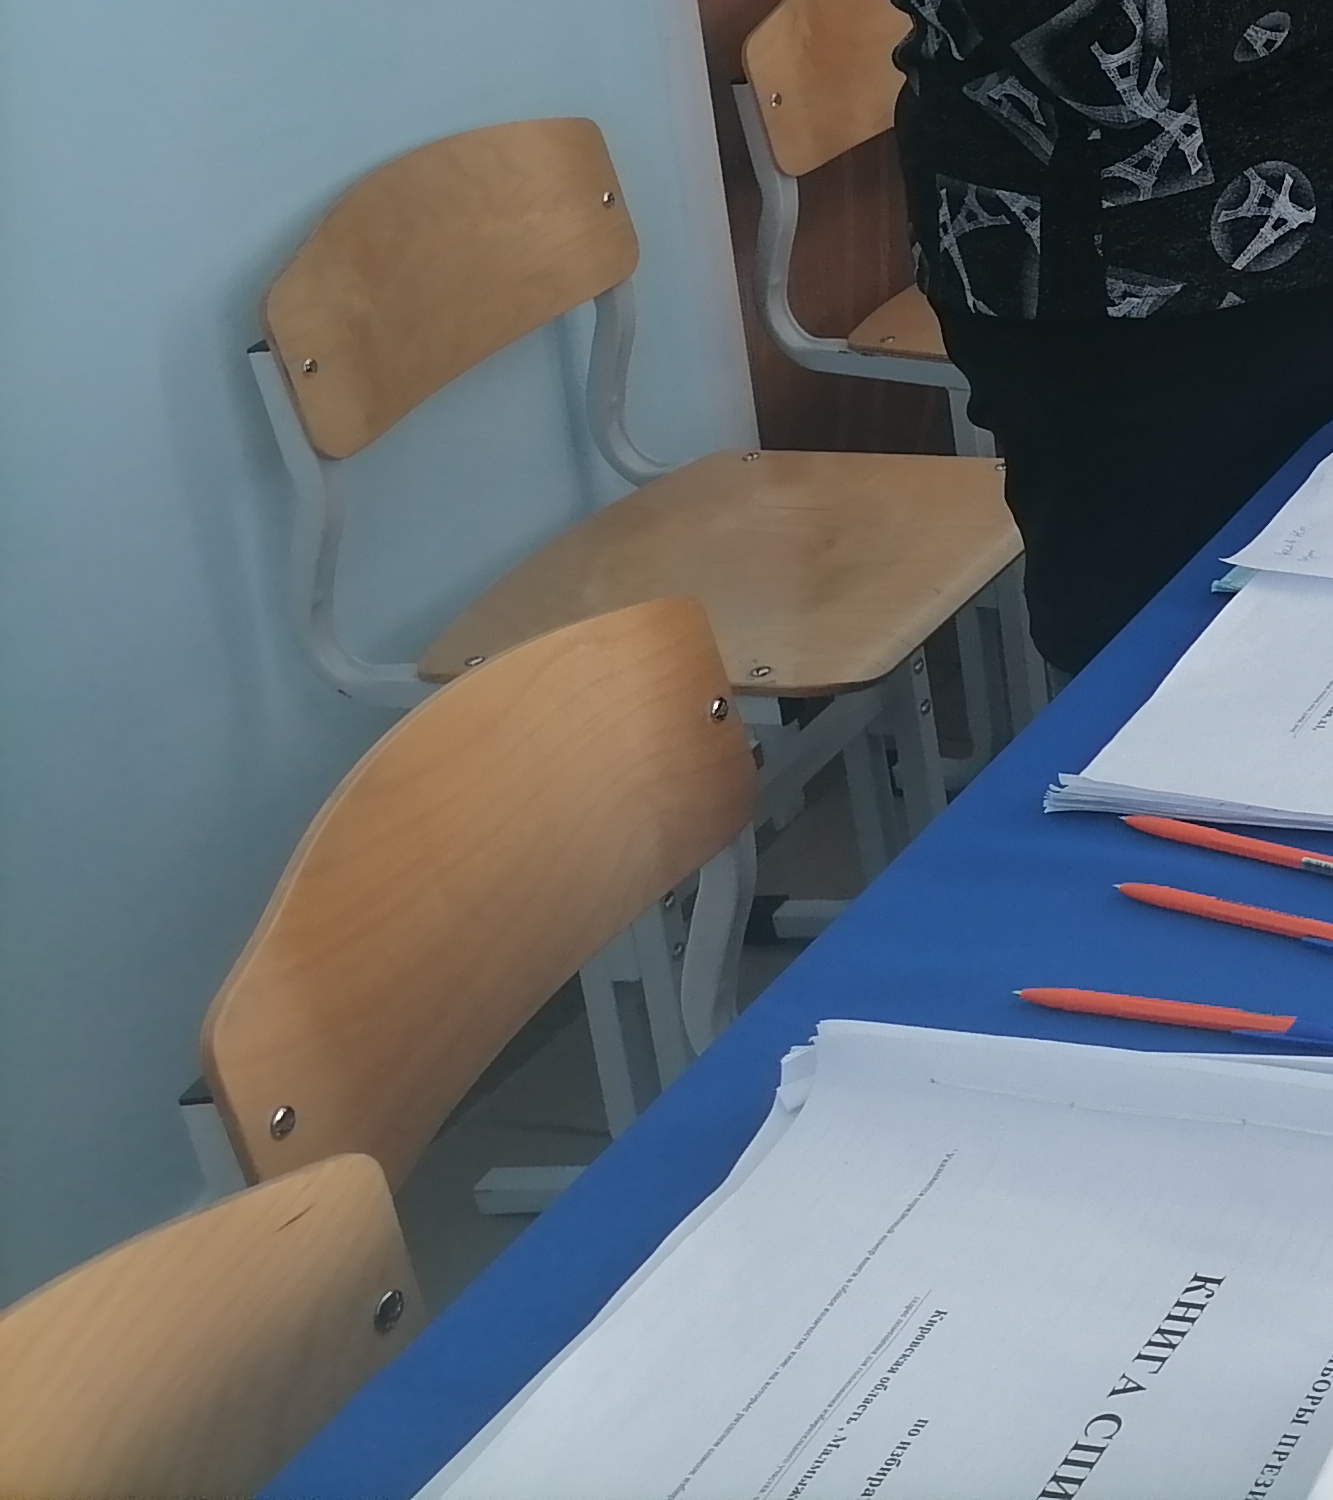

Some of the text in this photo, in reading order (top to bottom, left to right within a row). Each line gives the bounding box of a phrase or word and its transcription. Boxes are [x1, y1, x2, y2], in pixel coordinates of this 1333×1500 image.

[887, 1309, 949, 1374] Кировская
[845, 1376, 891, 1424] область
[1035, 1271, 1227, 1500] КНИГА СПИ
[860, 1418, 929, 1499] по избира
[1244, 1433, 1302, 1500] ПРЕЗИ
